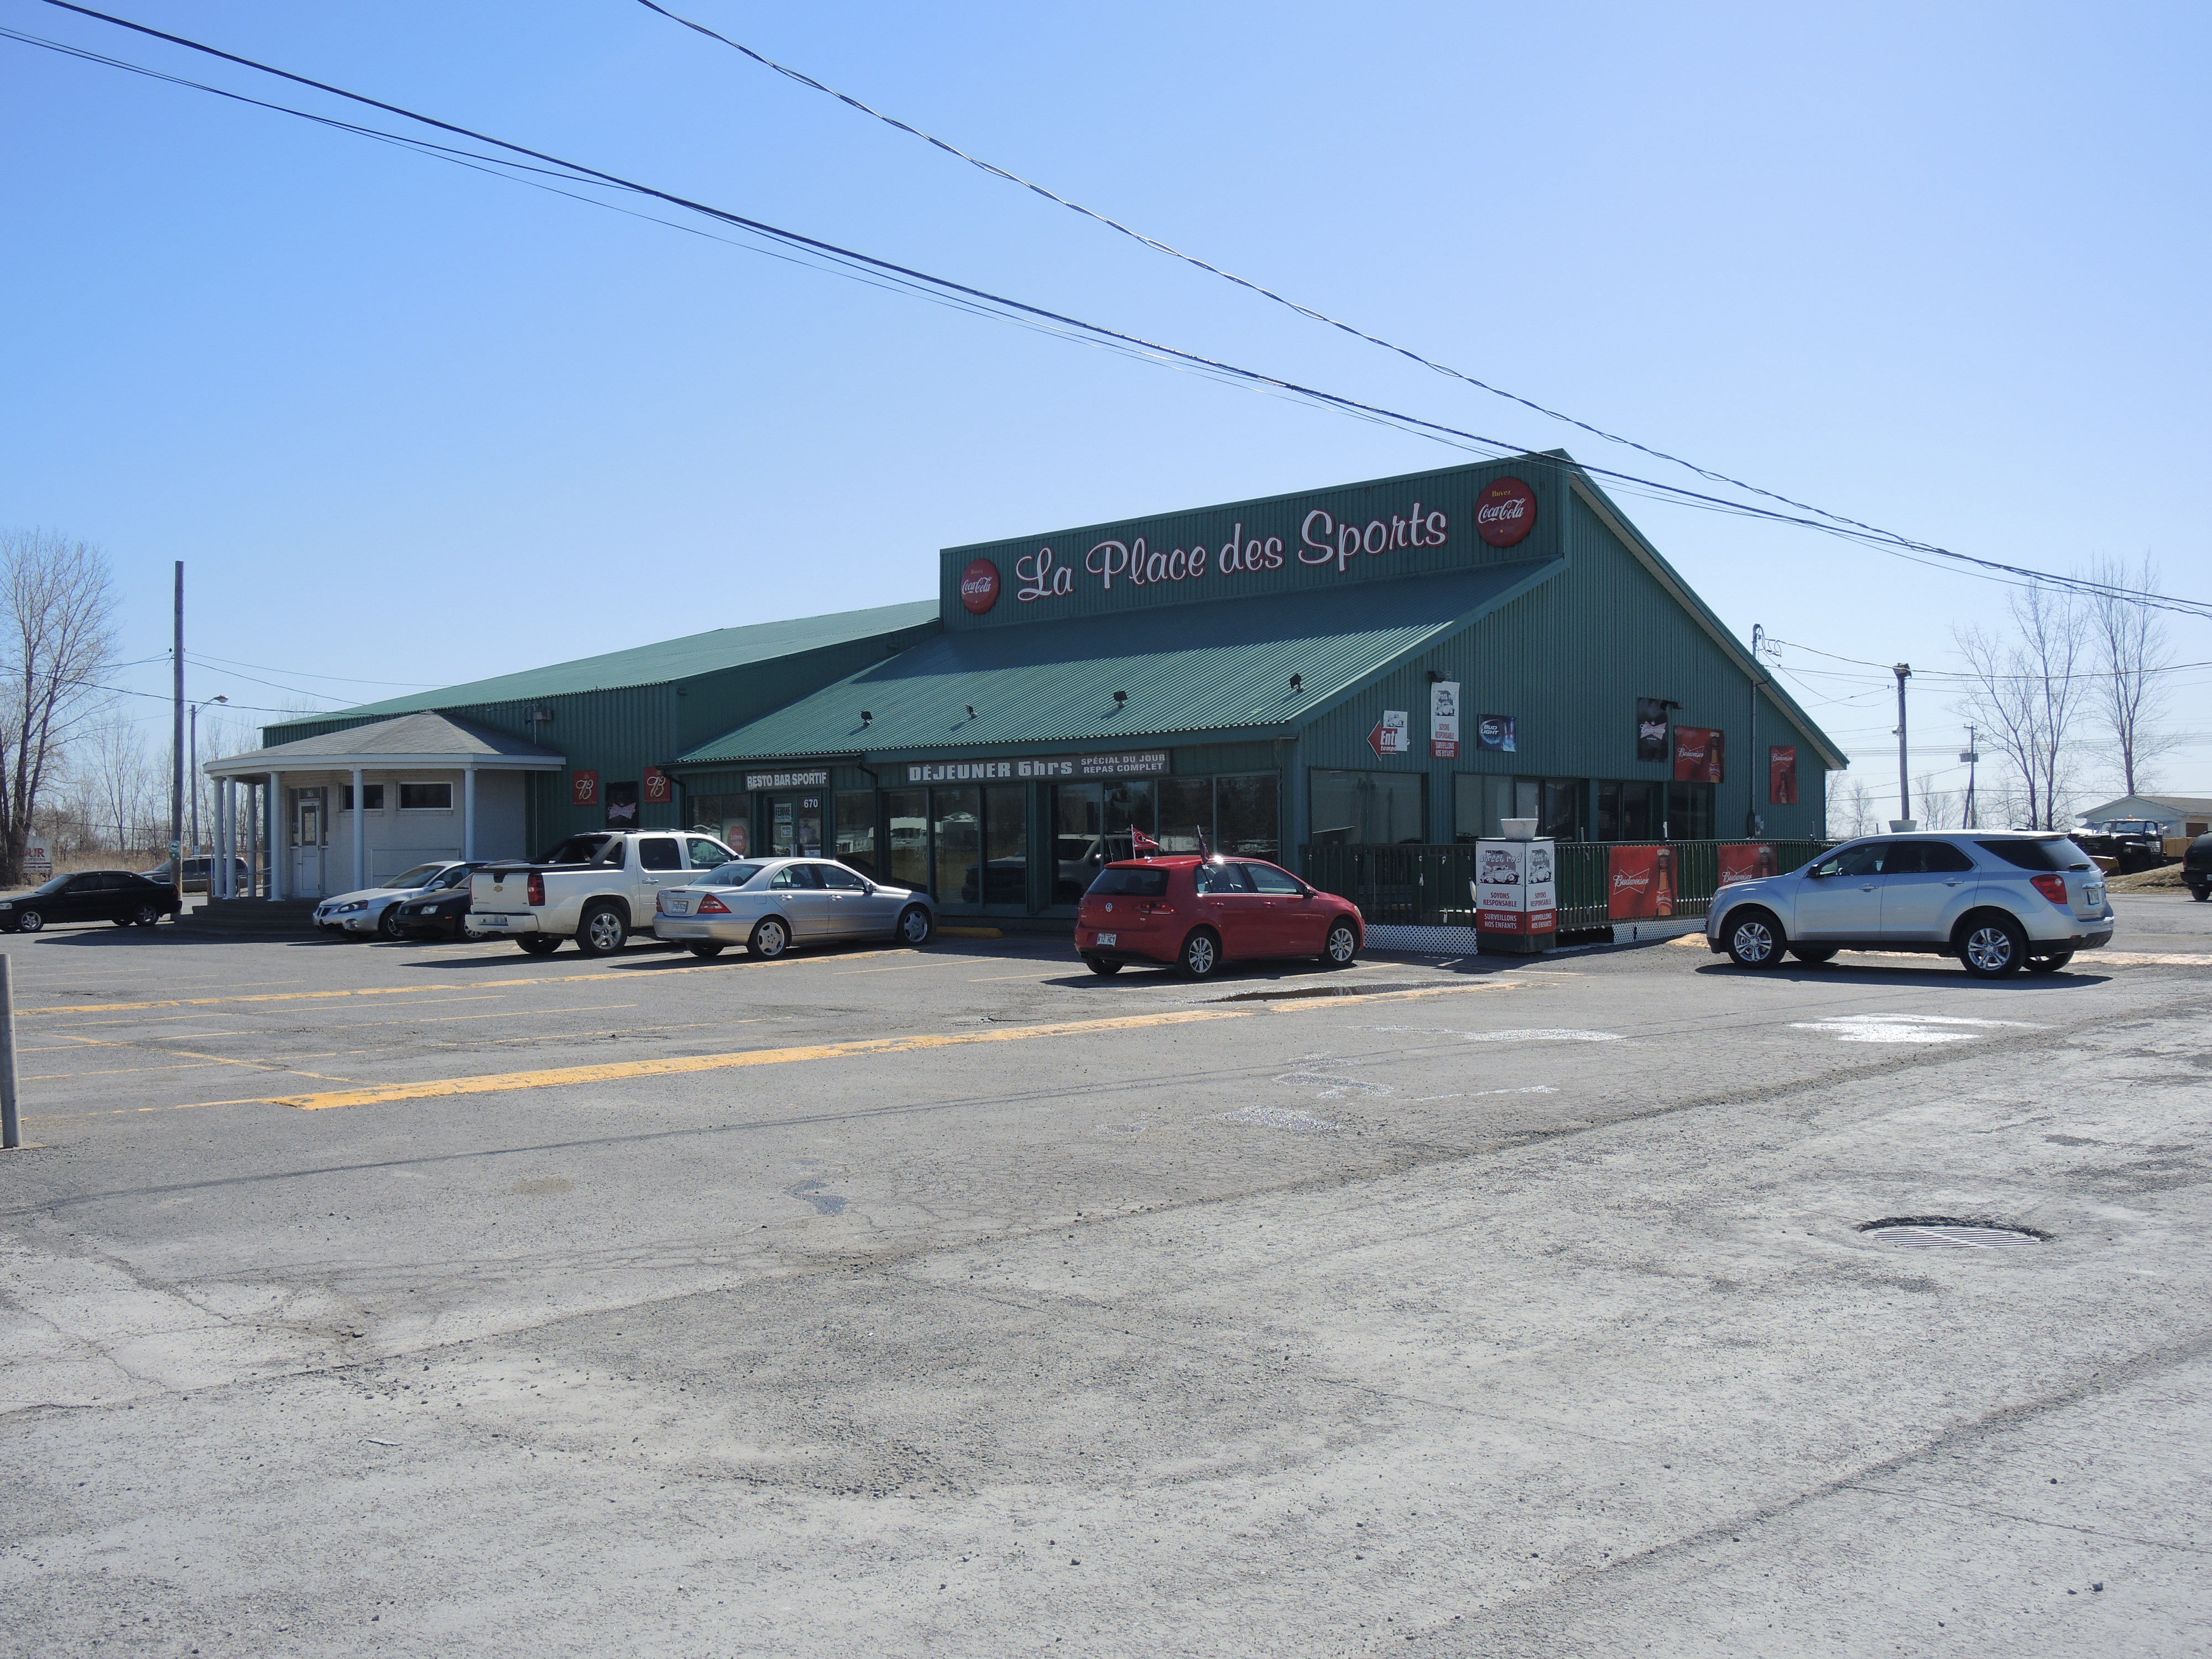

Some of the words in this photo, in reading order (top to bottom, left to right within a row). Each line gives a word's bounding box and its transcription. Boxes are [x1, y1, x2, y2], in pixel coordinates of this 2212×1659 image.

[1478, 498, 1526, 523] Coca-Cola
[1015, 546, 1073, 602] La
[1085, 536, 1207, 589] Place
[1218, 522, 1284, 574] des
[1297, 501, 1448, 572] Sports
[962, 576, 993, 595] Coca-Cola
[1081, 757, 1120, 765] SPÉCIAL
[1117, 763, 1163, 772] COMPLET
[909, 762, 1011, 781] DÉJEUNER
[1018, 761, 1072, 776] 6hrs
[747, 775, 773, 787] RESTO
[774, 774, 790, 786] BAR
[792, 772, 827, 785] SPORTIF
[804, 799, 818, 808] 670
[1479, 853, 1504, 863] street
[1507, 852, 1522, 863] rod
[1613, 874, 1649, 887] Budweiser
